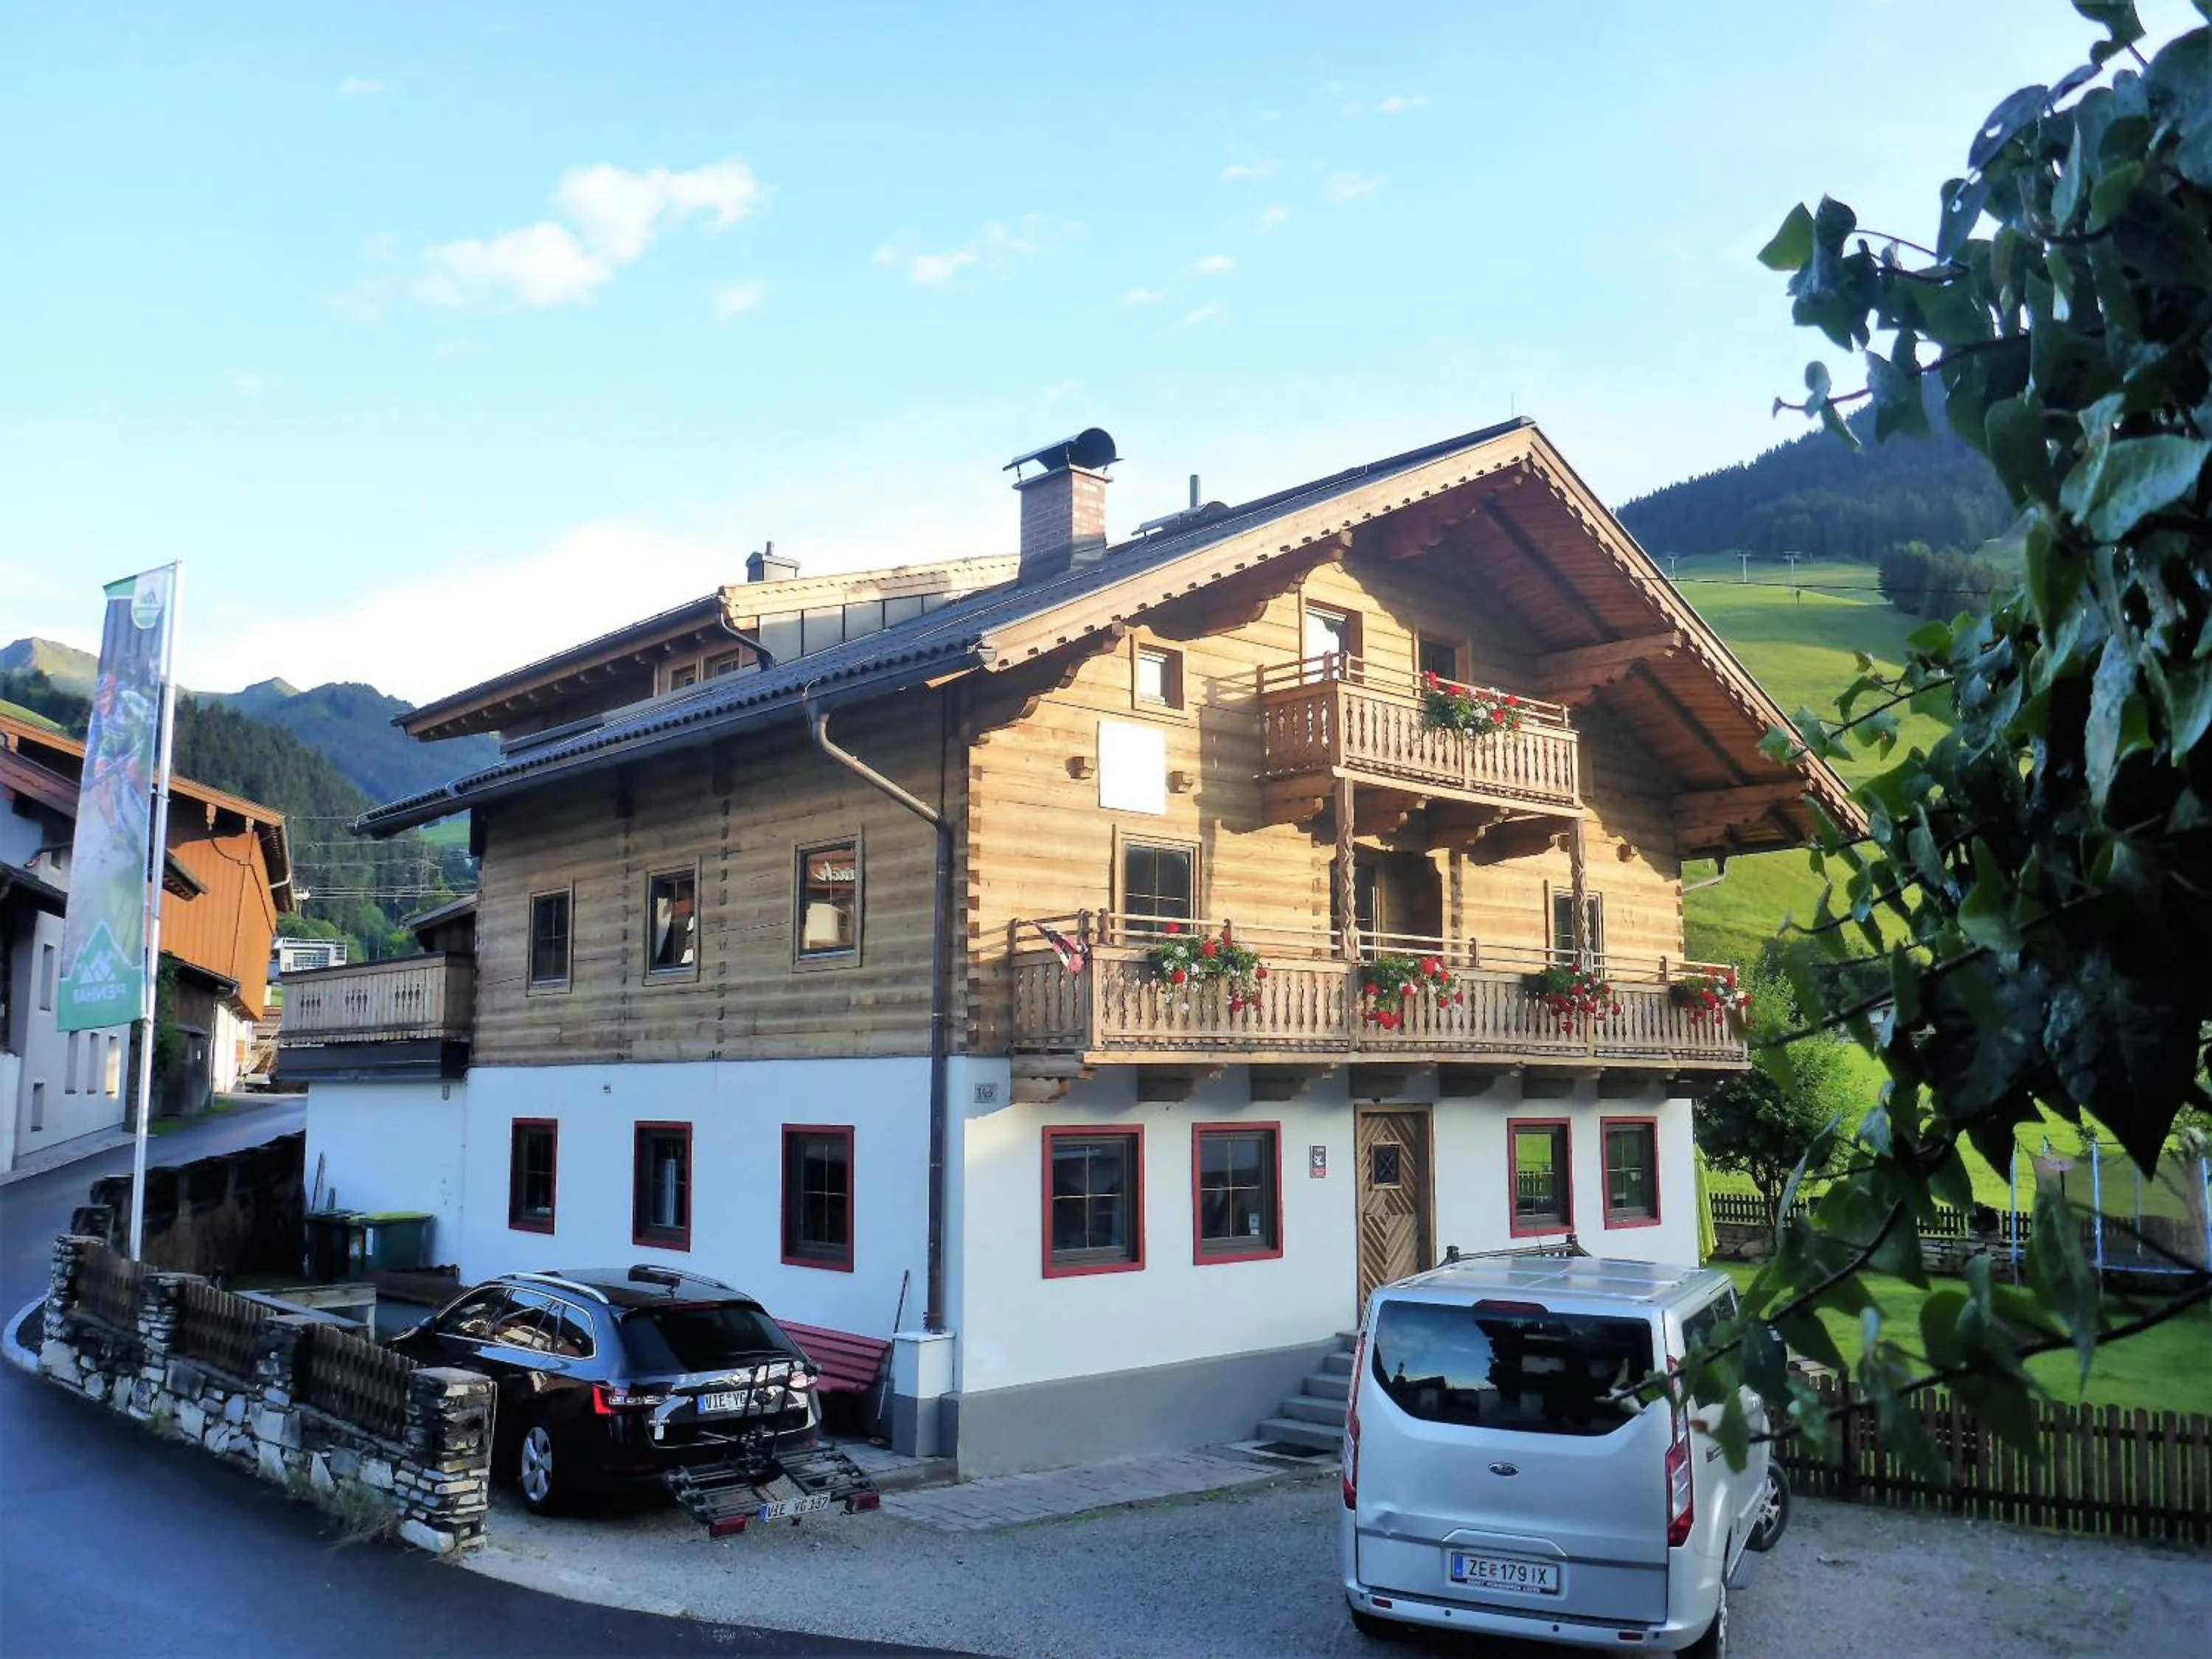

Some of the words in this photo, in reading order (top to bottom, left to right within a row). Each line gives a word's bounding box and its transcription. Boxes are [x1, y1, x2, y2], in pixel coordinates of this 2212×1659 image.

[706, 1394, 726, 1408] VIE
[768, 1503, 785, 1517] VIE
[1469, 1559, 1487, 1577] ZE
[1500, 1564, 1527, 1582] 179
[1531, 1568, 1546, 1585] IX
